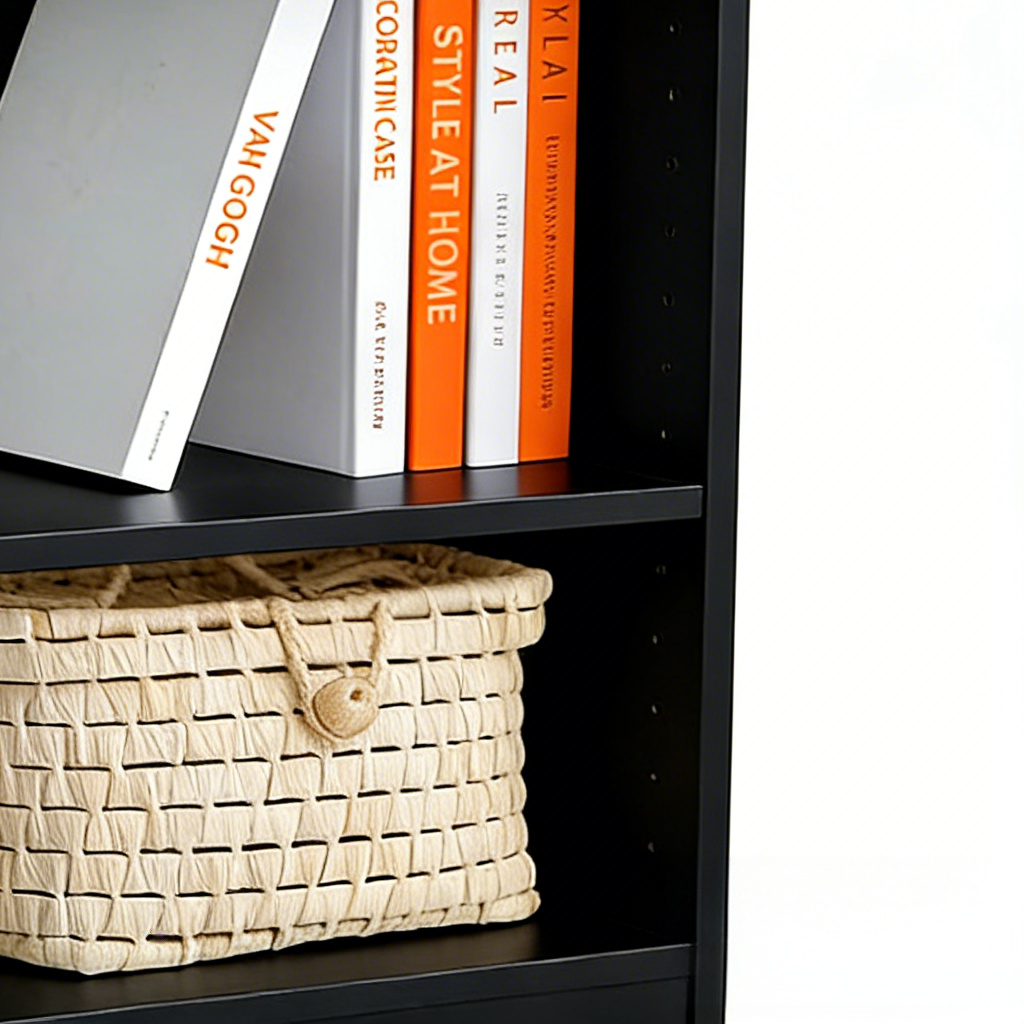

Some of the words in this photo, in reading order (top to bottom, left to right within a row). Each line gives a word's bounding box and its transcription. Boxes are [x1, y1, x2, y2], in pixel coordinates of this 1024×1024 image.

[431, 25, 464, 141] STYLE
[206, 174, 256, 270] GOGH
[429, 148, 460, 198] AT
[427, 210, 461, 325] HOME
